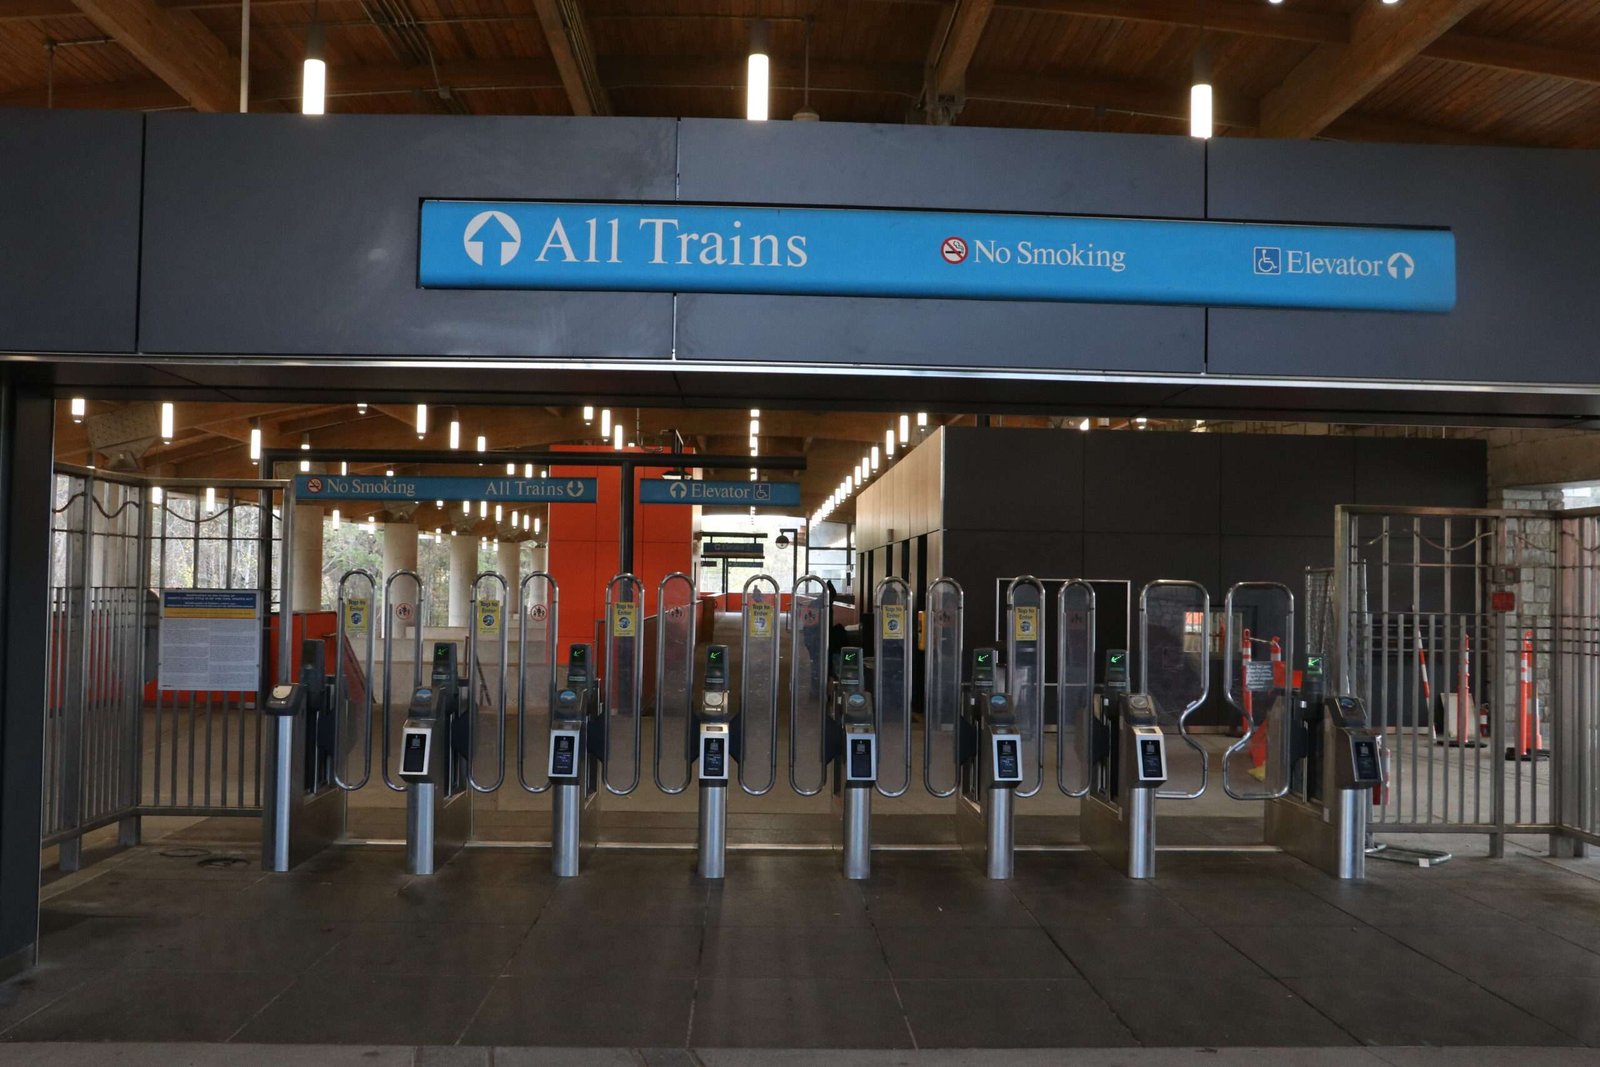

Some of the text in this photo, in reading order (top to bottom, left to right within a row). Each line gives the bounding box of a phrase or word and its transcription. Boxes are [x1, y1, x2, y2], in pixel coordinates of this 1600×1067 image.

[535, 217, 808, 268] All Trains
[973, 239, 1127, 272] No Smoking
[1286, 250, 1383, 278] Elevator
[327, 478, 416, 497] No Smoking
[485, 481, 564, 496] All Trains
[691, 483, 751, 499] Elevator
